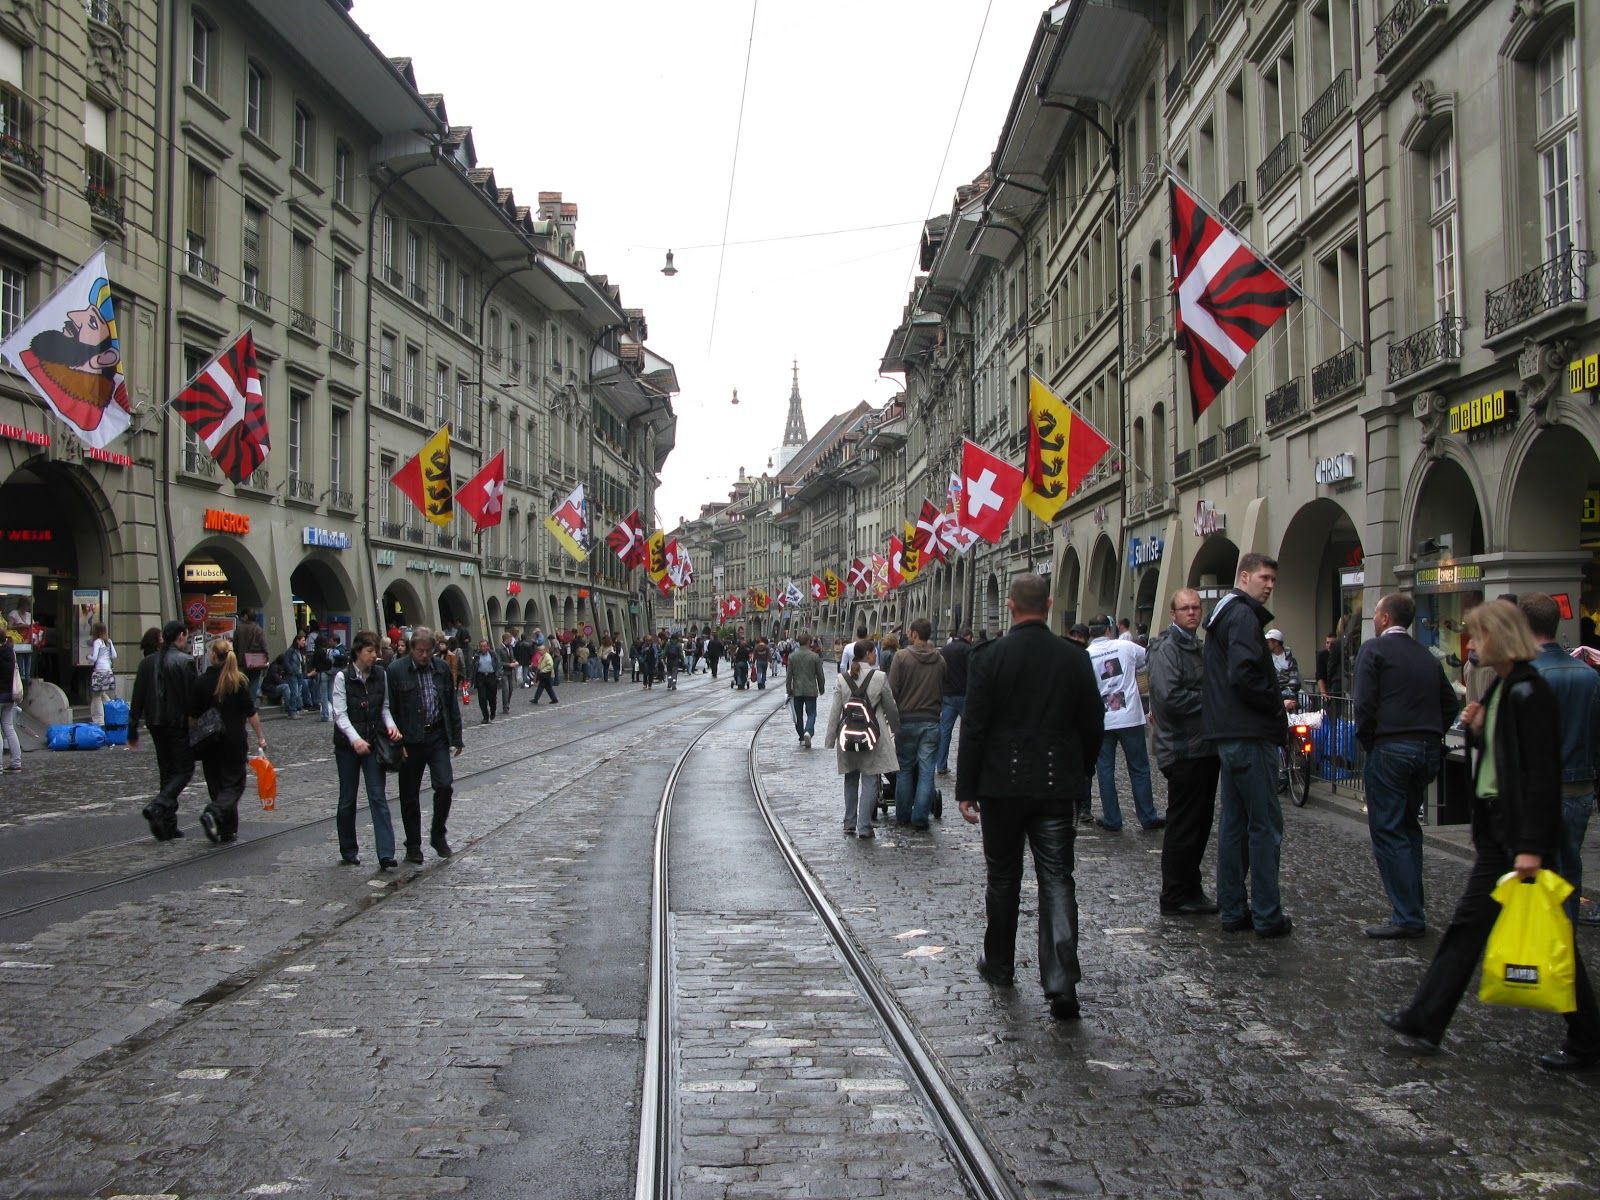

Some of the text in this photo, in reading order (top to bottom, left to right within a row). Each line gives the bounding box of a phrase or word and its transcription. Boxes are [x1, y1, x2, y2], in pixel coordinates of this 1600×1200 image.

[1450, 391, 1504, 433] metro
[1315, 452, 1347, 484] CHRIST
[205, 509, 250, 534] MIGROS
[1135, 537, 1159, 565] sunrise
